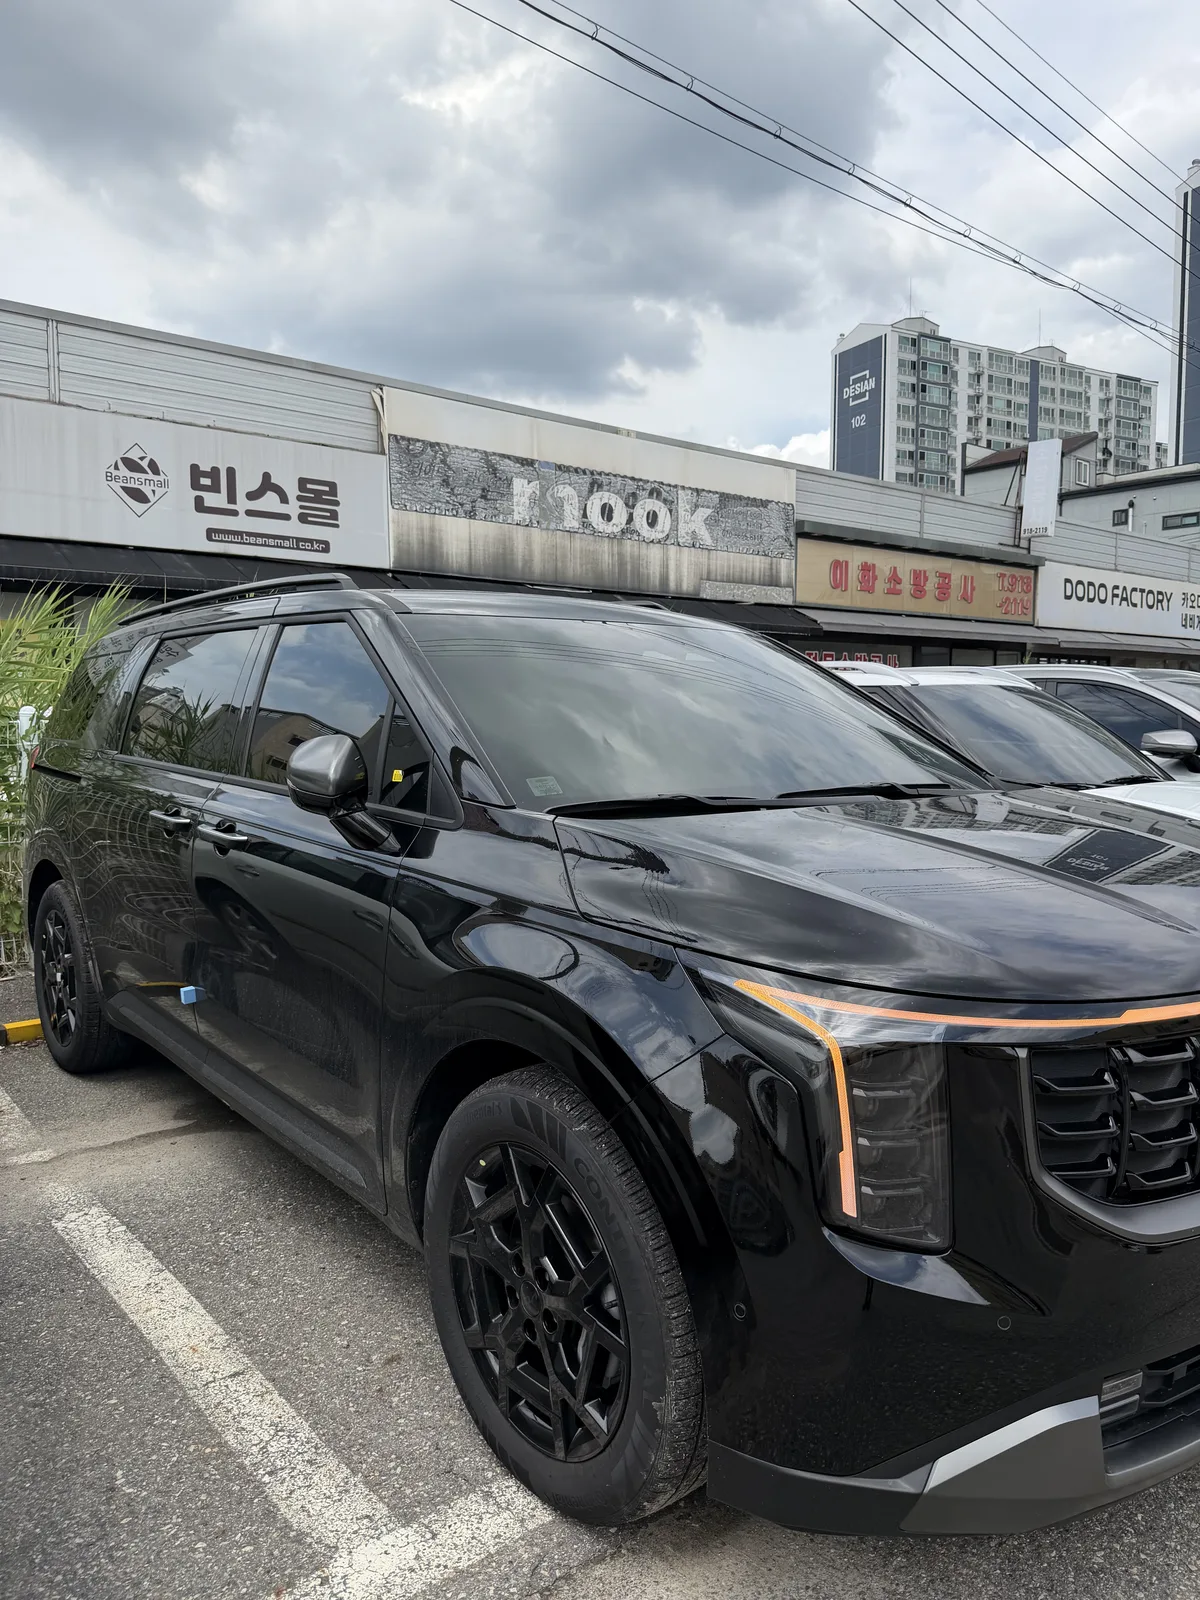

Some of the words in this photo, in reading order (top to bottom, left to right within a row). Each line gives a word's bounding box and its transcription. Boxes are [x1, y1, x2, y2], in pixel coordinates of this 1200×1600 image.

[843, 377, 876, 399] DESIAN
[851, 414, 867, 429] 102
[105, 471, 169, 489] Beansmall
[190, 463, 341, 529] 빈스몰
[829, 559, 976, 604] 이화소방공사
[1063, 578, 1108, 604] DODO
[1111, 585, 1173, 611] FACTORY
